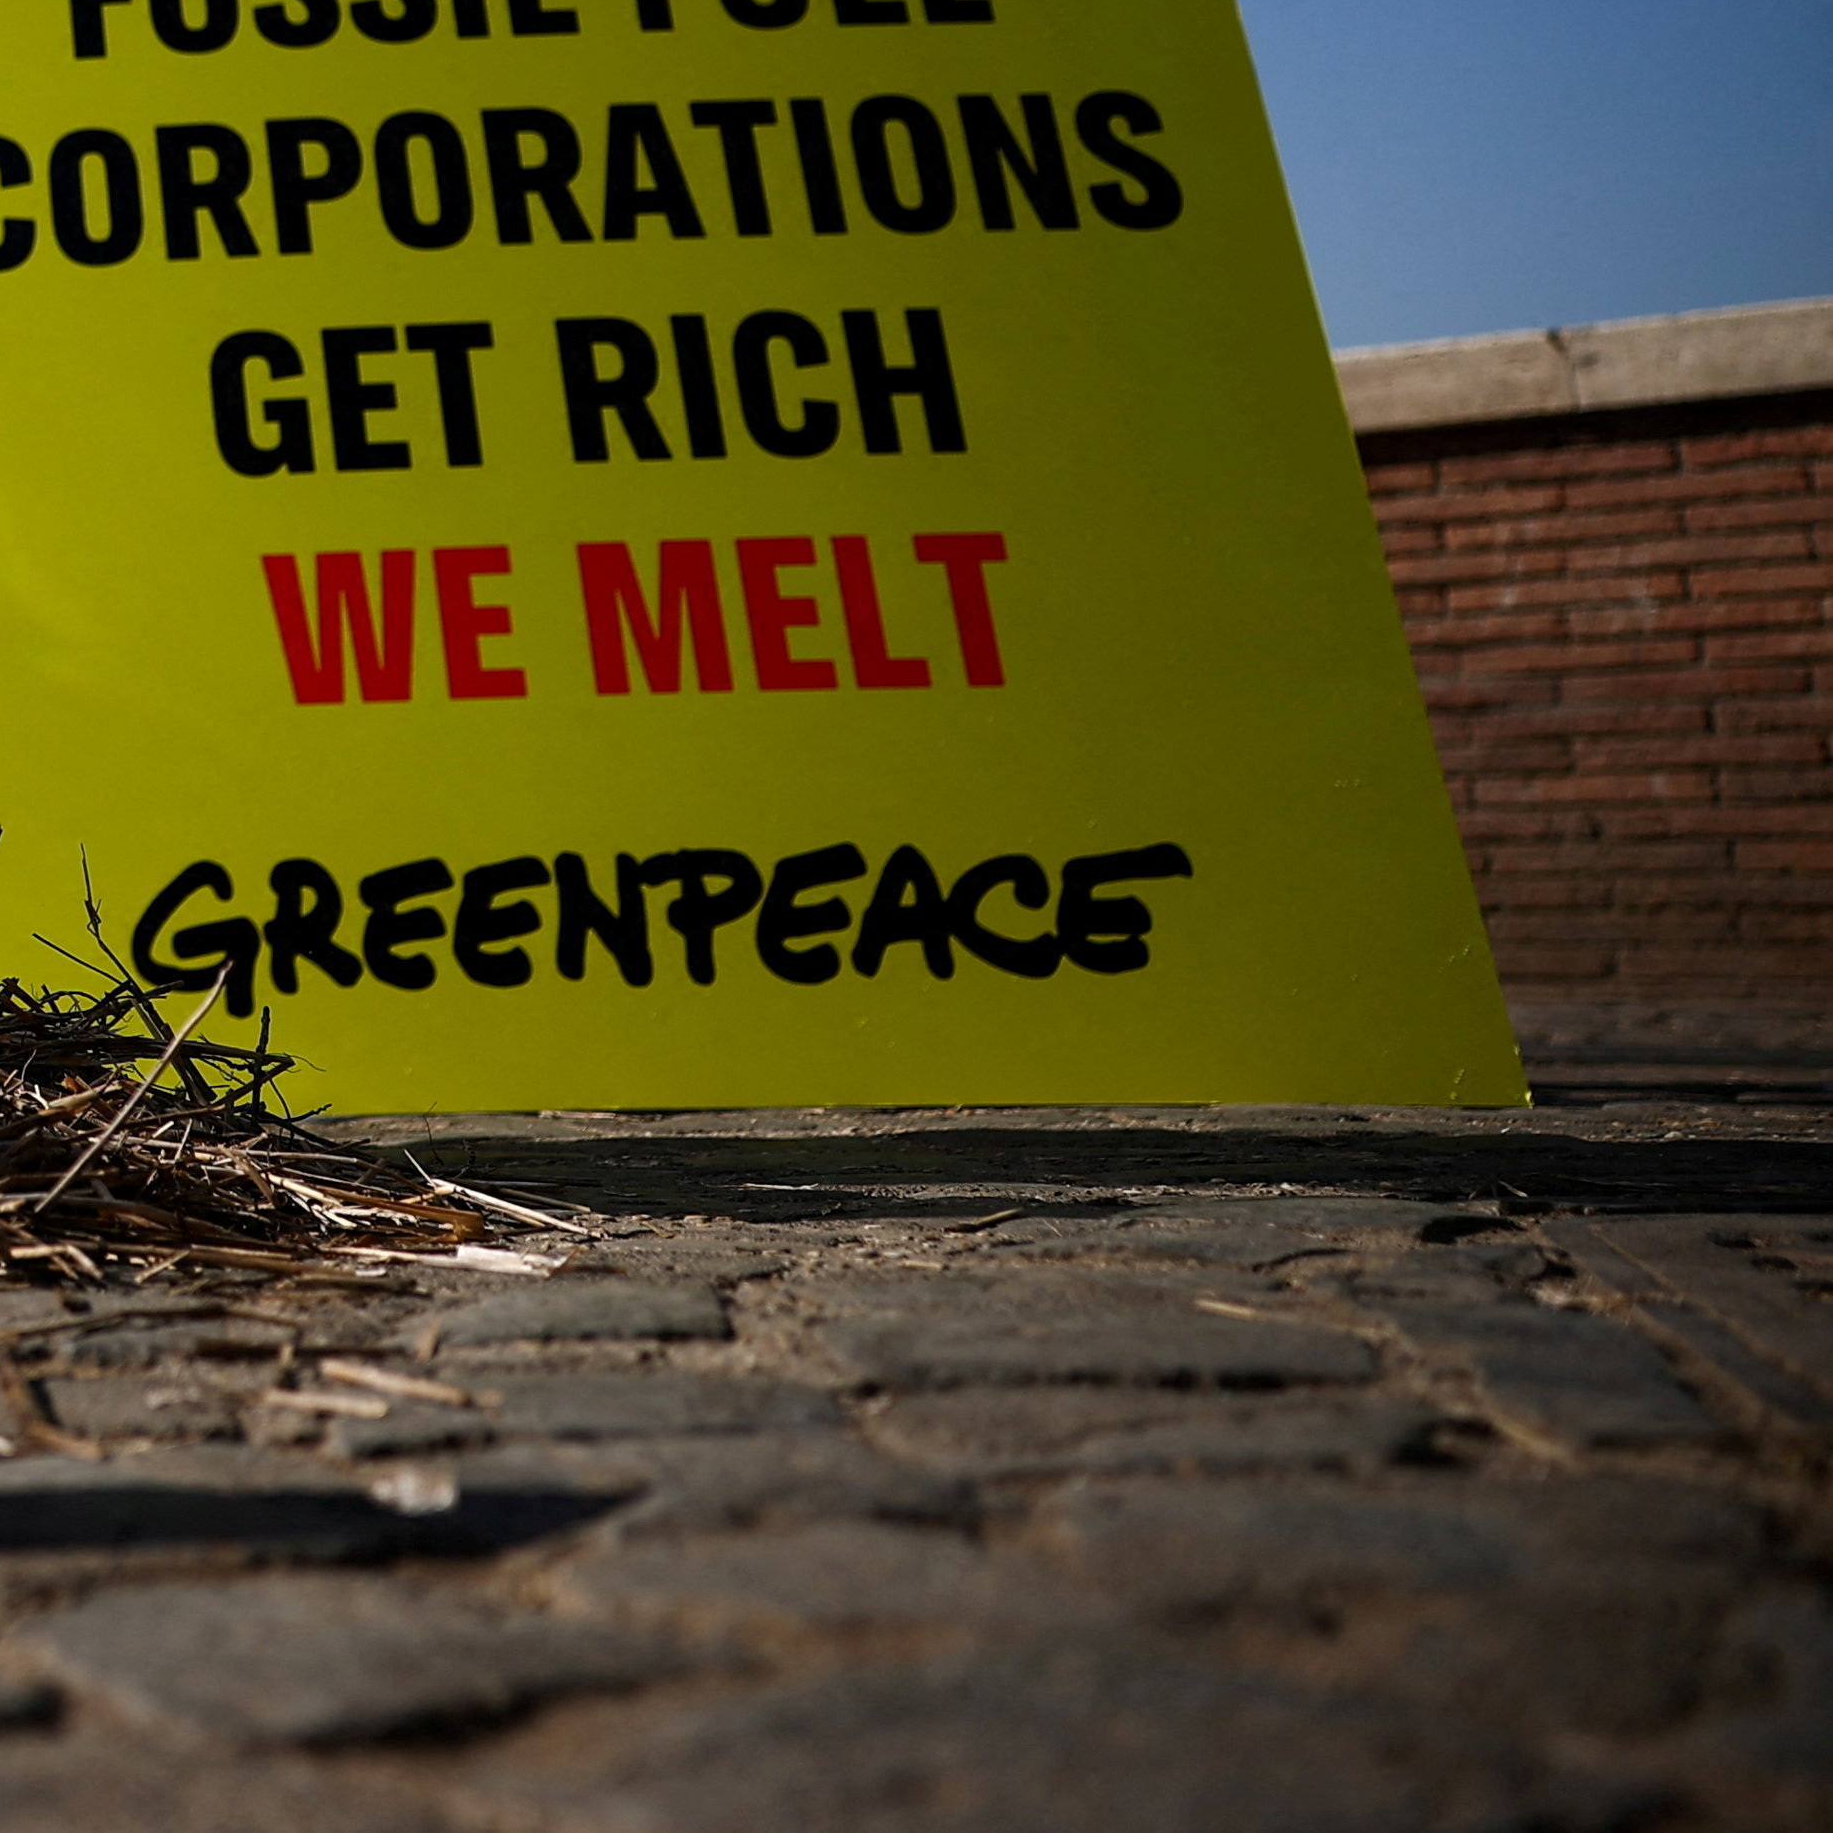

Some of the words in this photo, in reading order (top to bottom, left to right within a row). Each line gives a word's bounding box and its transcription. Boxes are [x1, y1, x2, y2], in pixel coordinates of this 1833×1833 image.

[209, 320, 494, 477] GET
[554, 306, 970, 464] RICH
[261, 544, 528, 706] WE
[575, 531, 1010, 697] MELT
[131, 840, 1194, 1019] GREENPEACE
